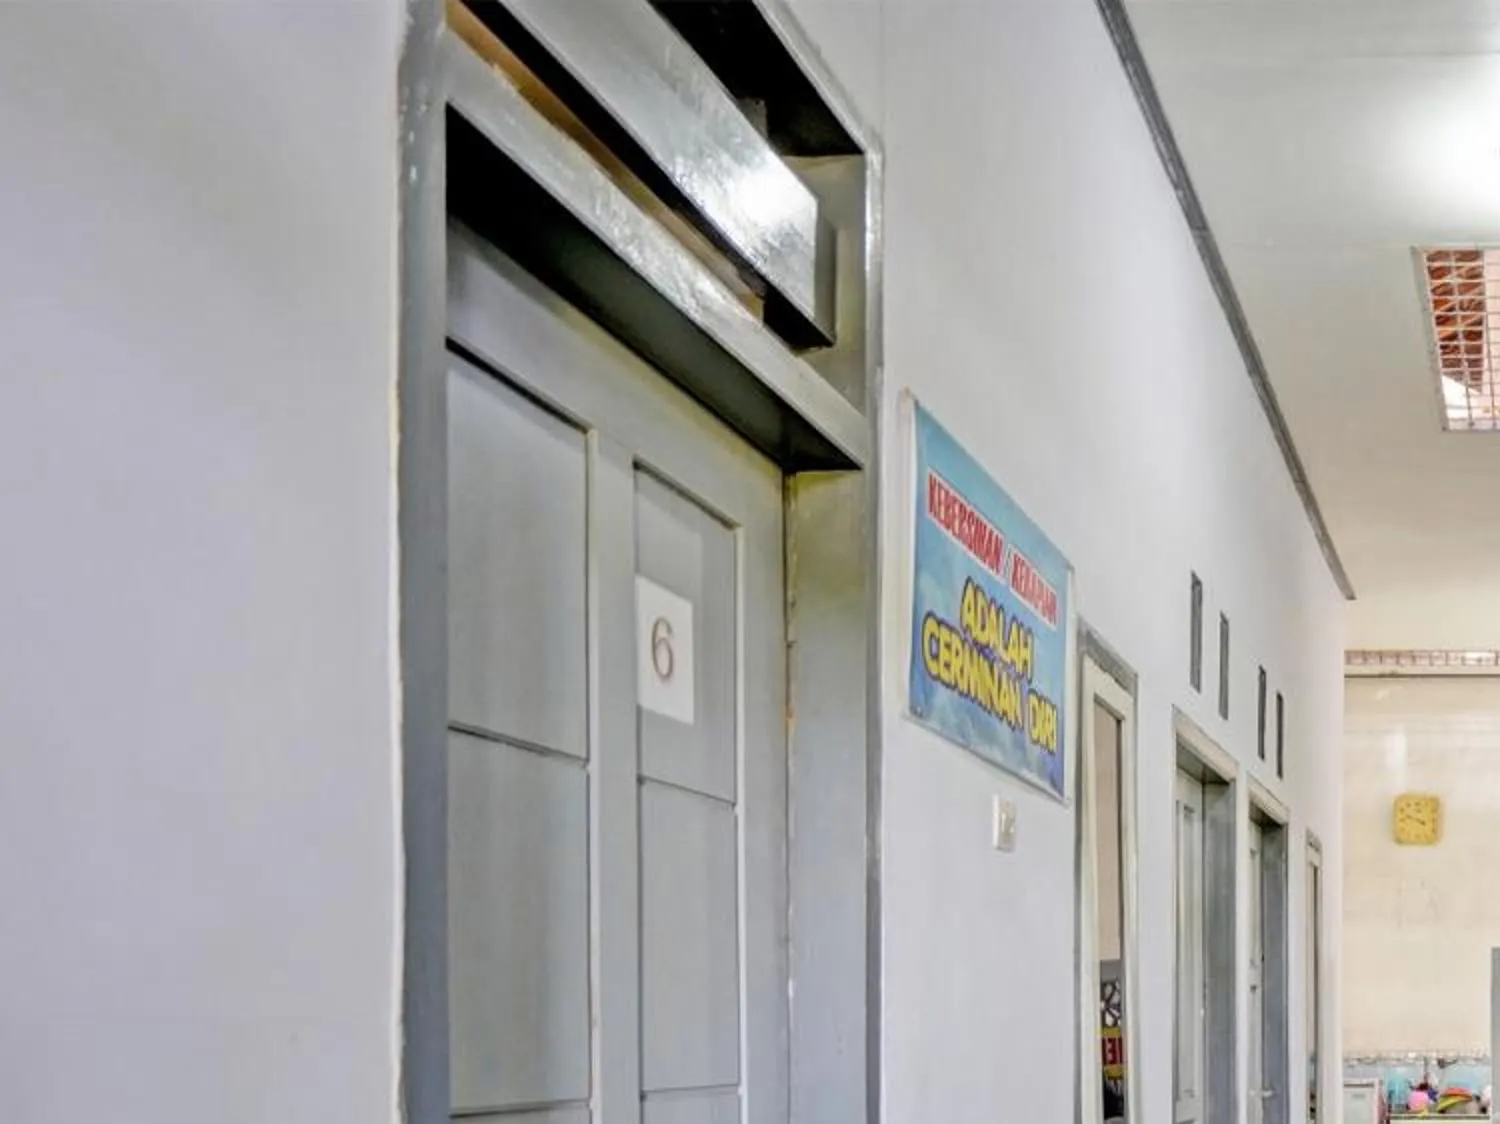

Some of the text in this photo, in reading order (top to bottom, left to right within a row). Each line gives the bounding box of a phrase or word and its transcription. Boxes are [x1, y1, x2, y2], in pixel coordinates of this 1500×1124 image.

[652, 616, 674, 682] 6
[922, 610, 1024, 731] CERMINAN
[960, 575, 1034, 686] ADALAH
